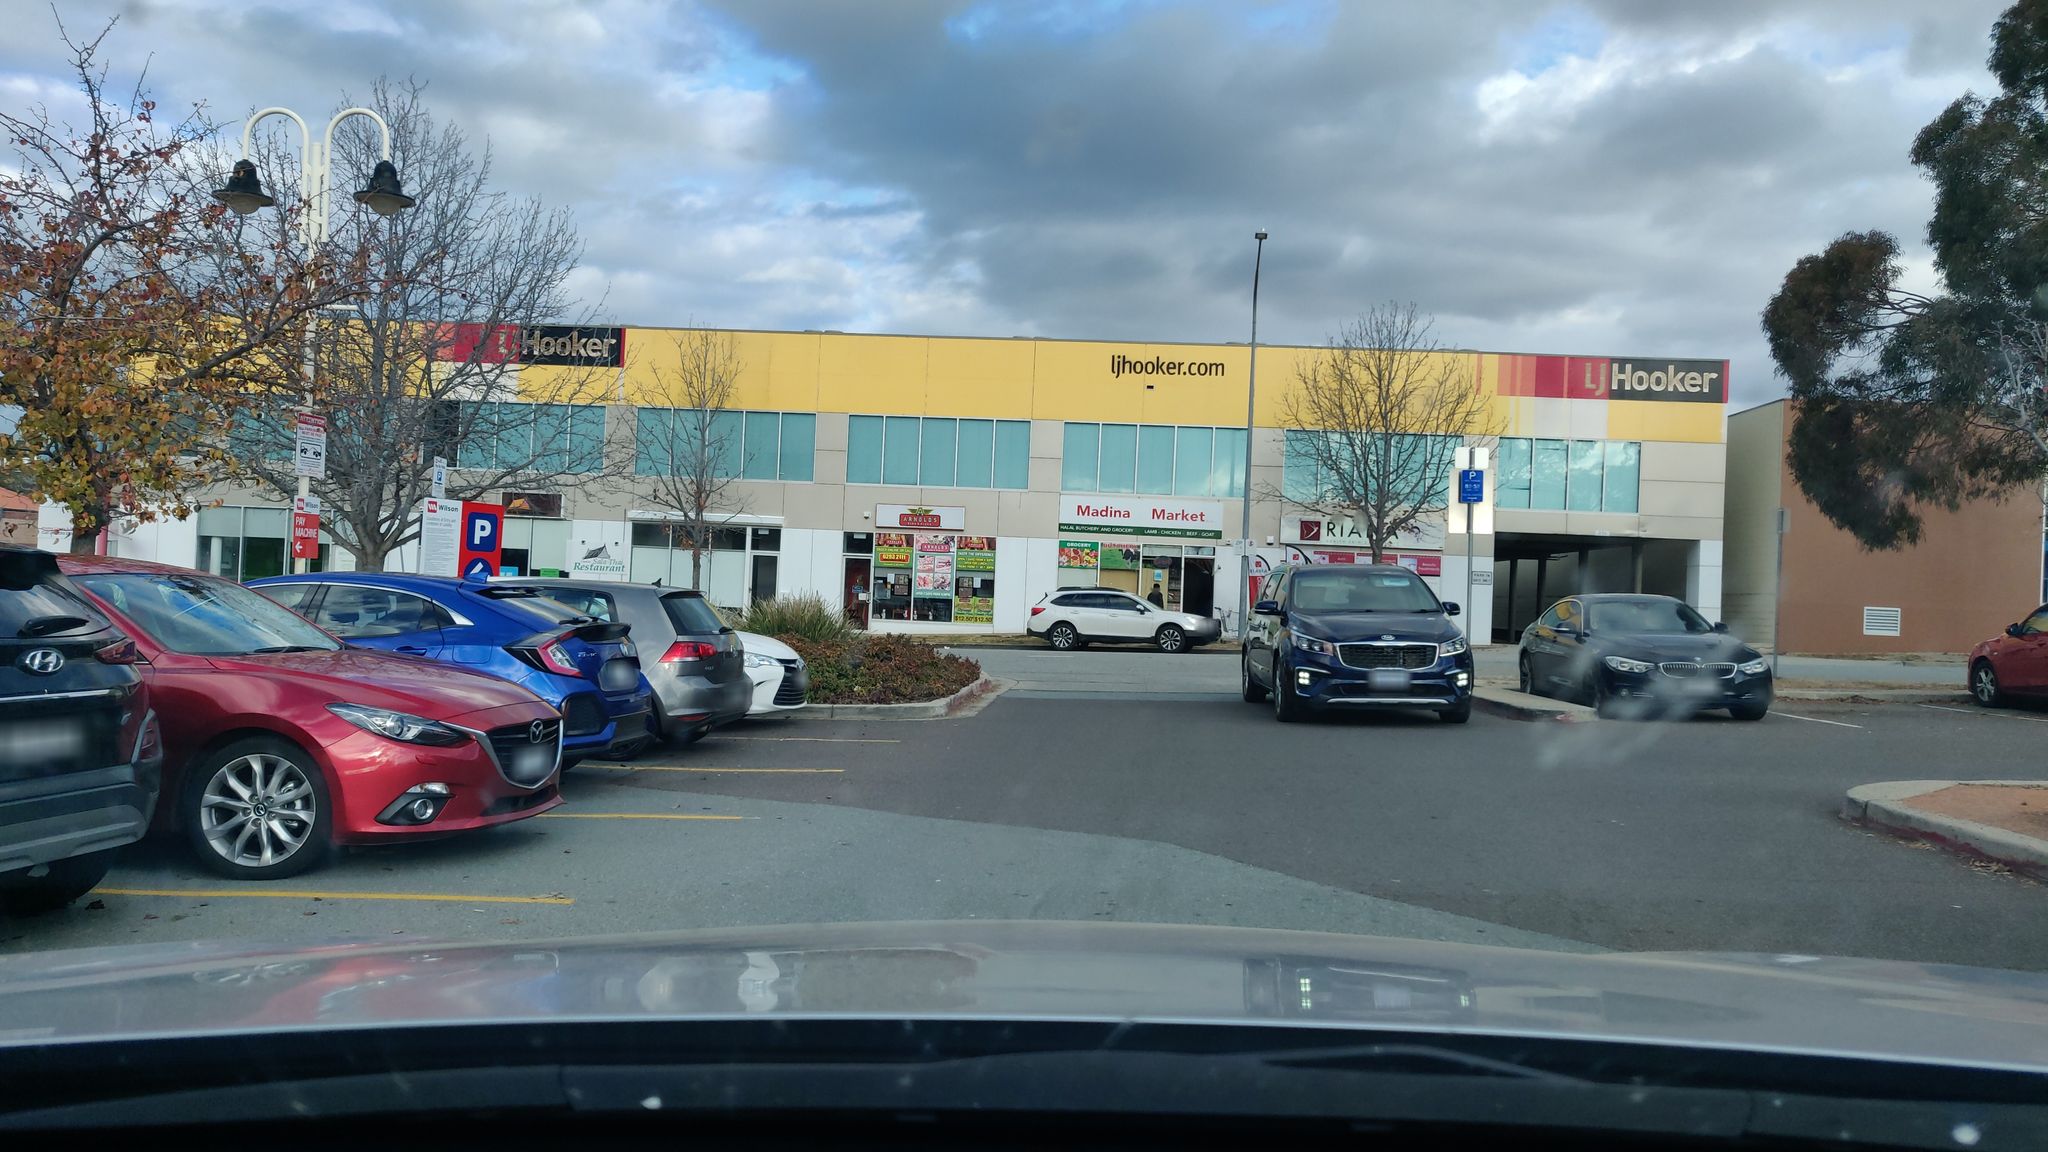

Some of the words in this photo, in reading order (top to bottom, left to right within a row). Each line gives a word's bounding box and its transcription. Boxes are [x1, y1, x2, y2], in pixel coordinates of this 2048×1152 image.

[522, 329, 617, 358] Hooker
[1111, 354, 1225, 379] ljhooker.com
[1584, 362, 1607, 397] LJ
[1611, 363, 1719, 393] Hooker
[1469, 471, 1477, 480] P
[438, 503, 459, 513] Wilson
[1076, 505, 1131, 519] Madina
[1151, 508, 1206, 522] Market
[295, 516, 306, 526] PAY
[295, 527, 318, 538] MACHINE
[473, 518, 492, 545] P
[573, 561, 625, 572] Restaurant
